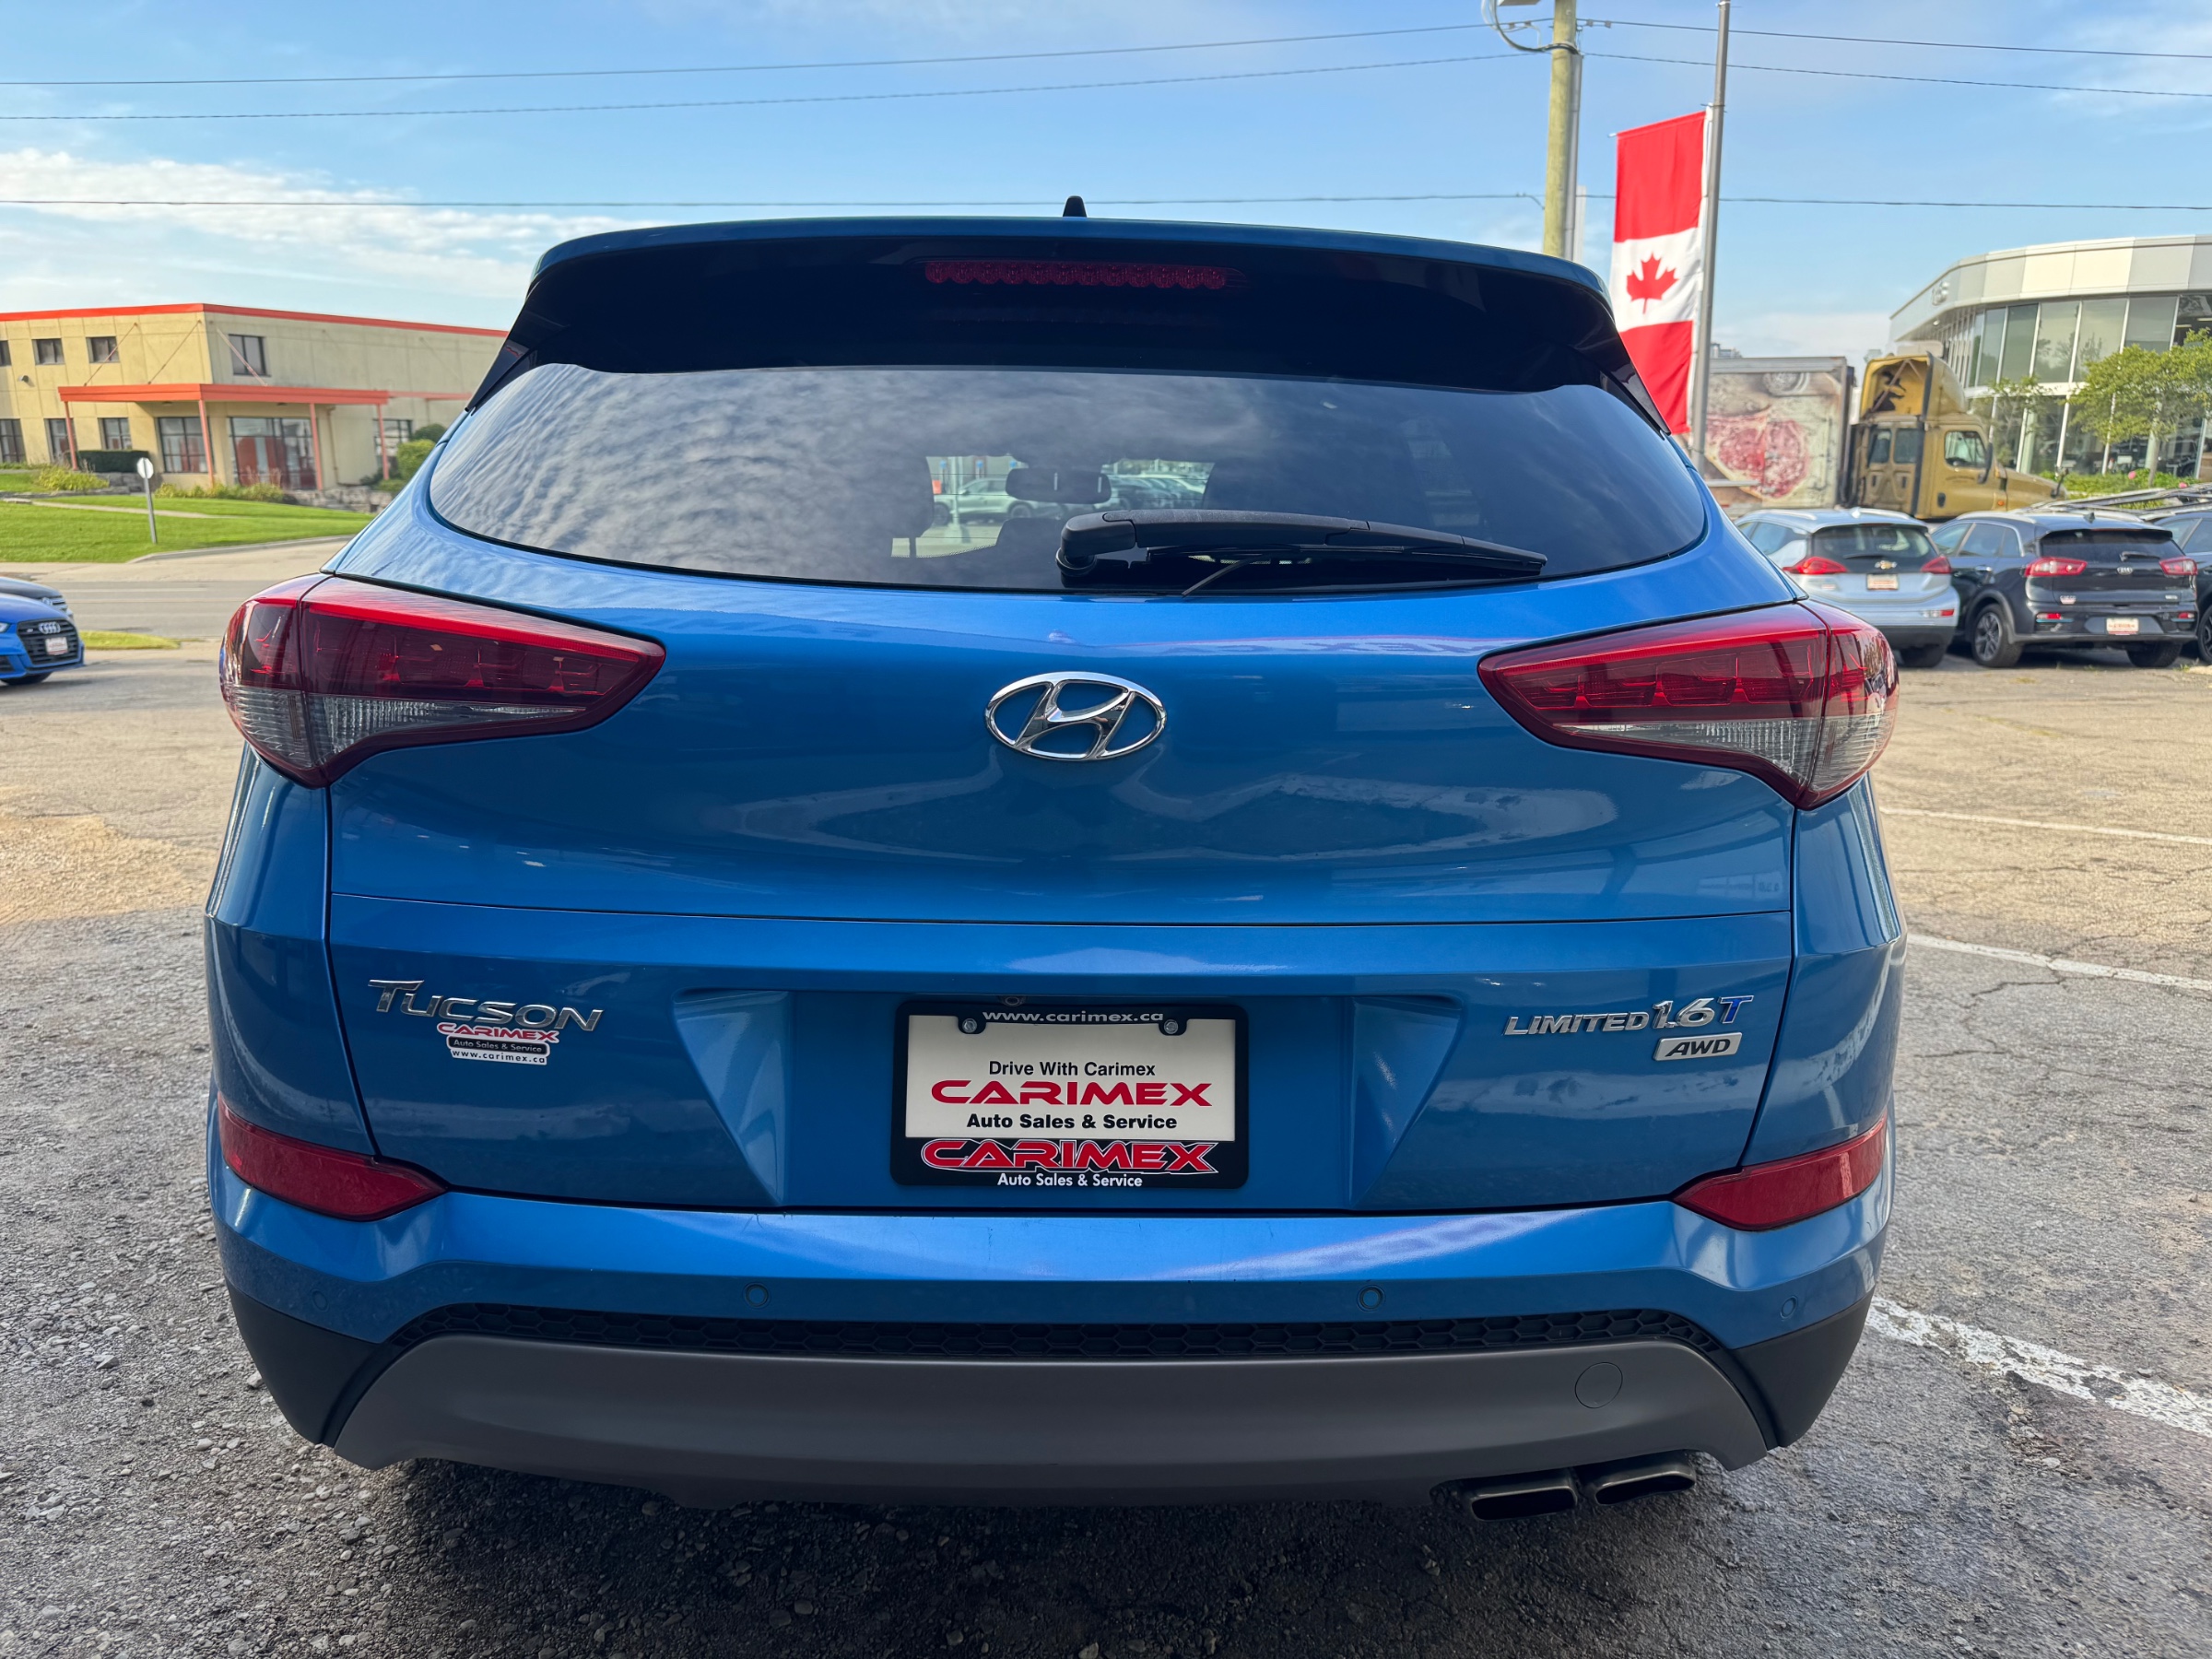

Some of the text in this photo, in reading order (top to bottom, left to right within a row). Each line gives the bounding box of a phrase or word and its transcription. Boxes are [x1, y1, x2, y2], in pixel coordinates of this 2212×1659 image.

[368, 979, 605, 1031] TUCSON
[982, 1010, 1164, 1023] www.carimex.ca
[1504, 1011, 1649, 1036] LIMITED
[438, 1023, 558, 1042] CARIMEX
[453, 1039, 475, 1048] Auto
[476, 1041, 500, 1050] Sales
[511, 1043, 543, 1053] Service
[1665, 1039, 1732, 1058] AWD
[452, 1050, 546, 1064] www.carimex.ca
[989, 1061, 1156, 1077] Drive With Carimex
[931, 1079, 1213, 1107] CARIMEX
[967, 1113, 1178, 1130] Auto Sales & Service
[922, 1139, 1217, 1173] CARIMEX
[996, 1172, 1143, 1188] Auto Sales & Service
